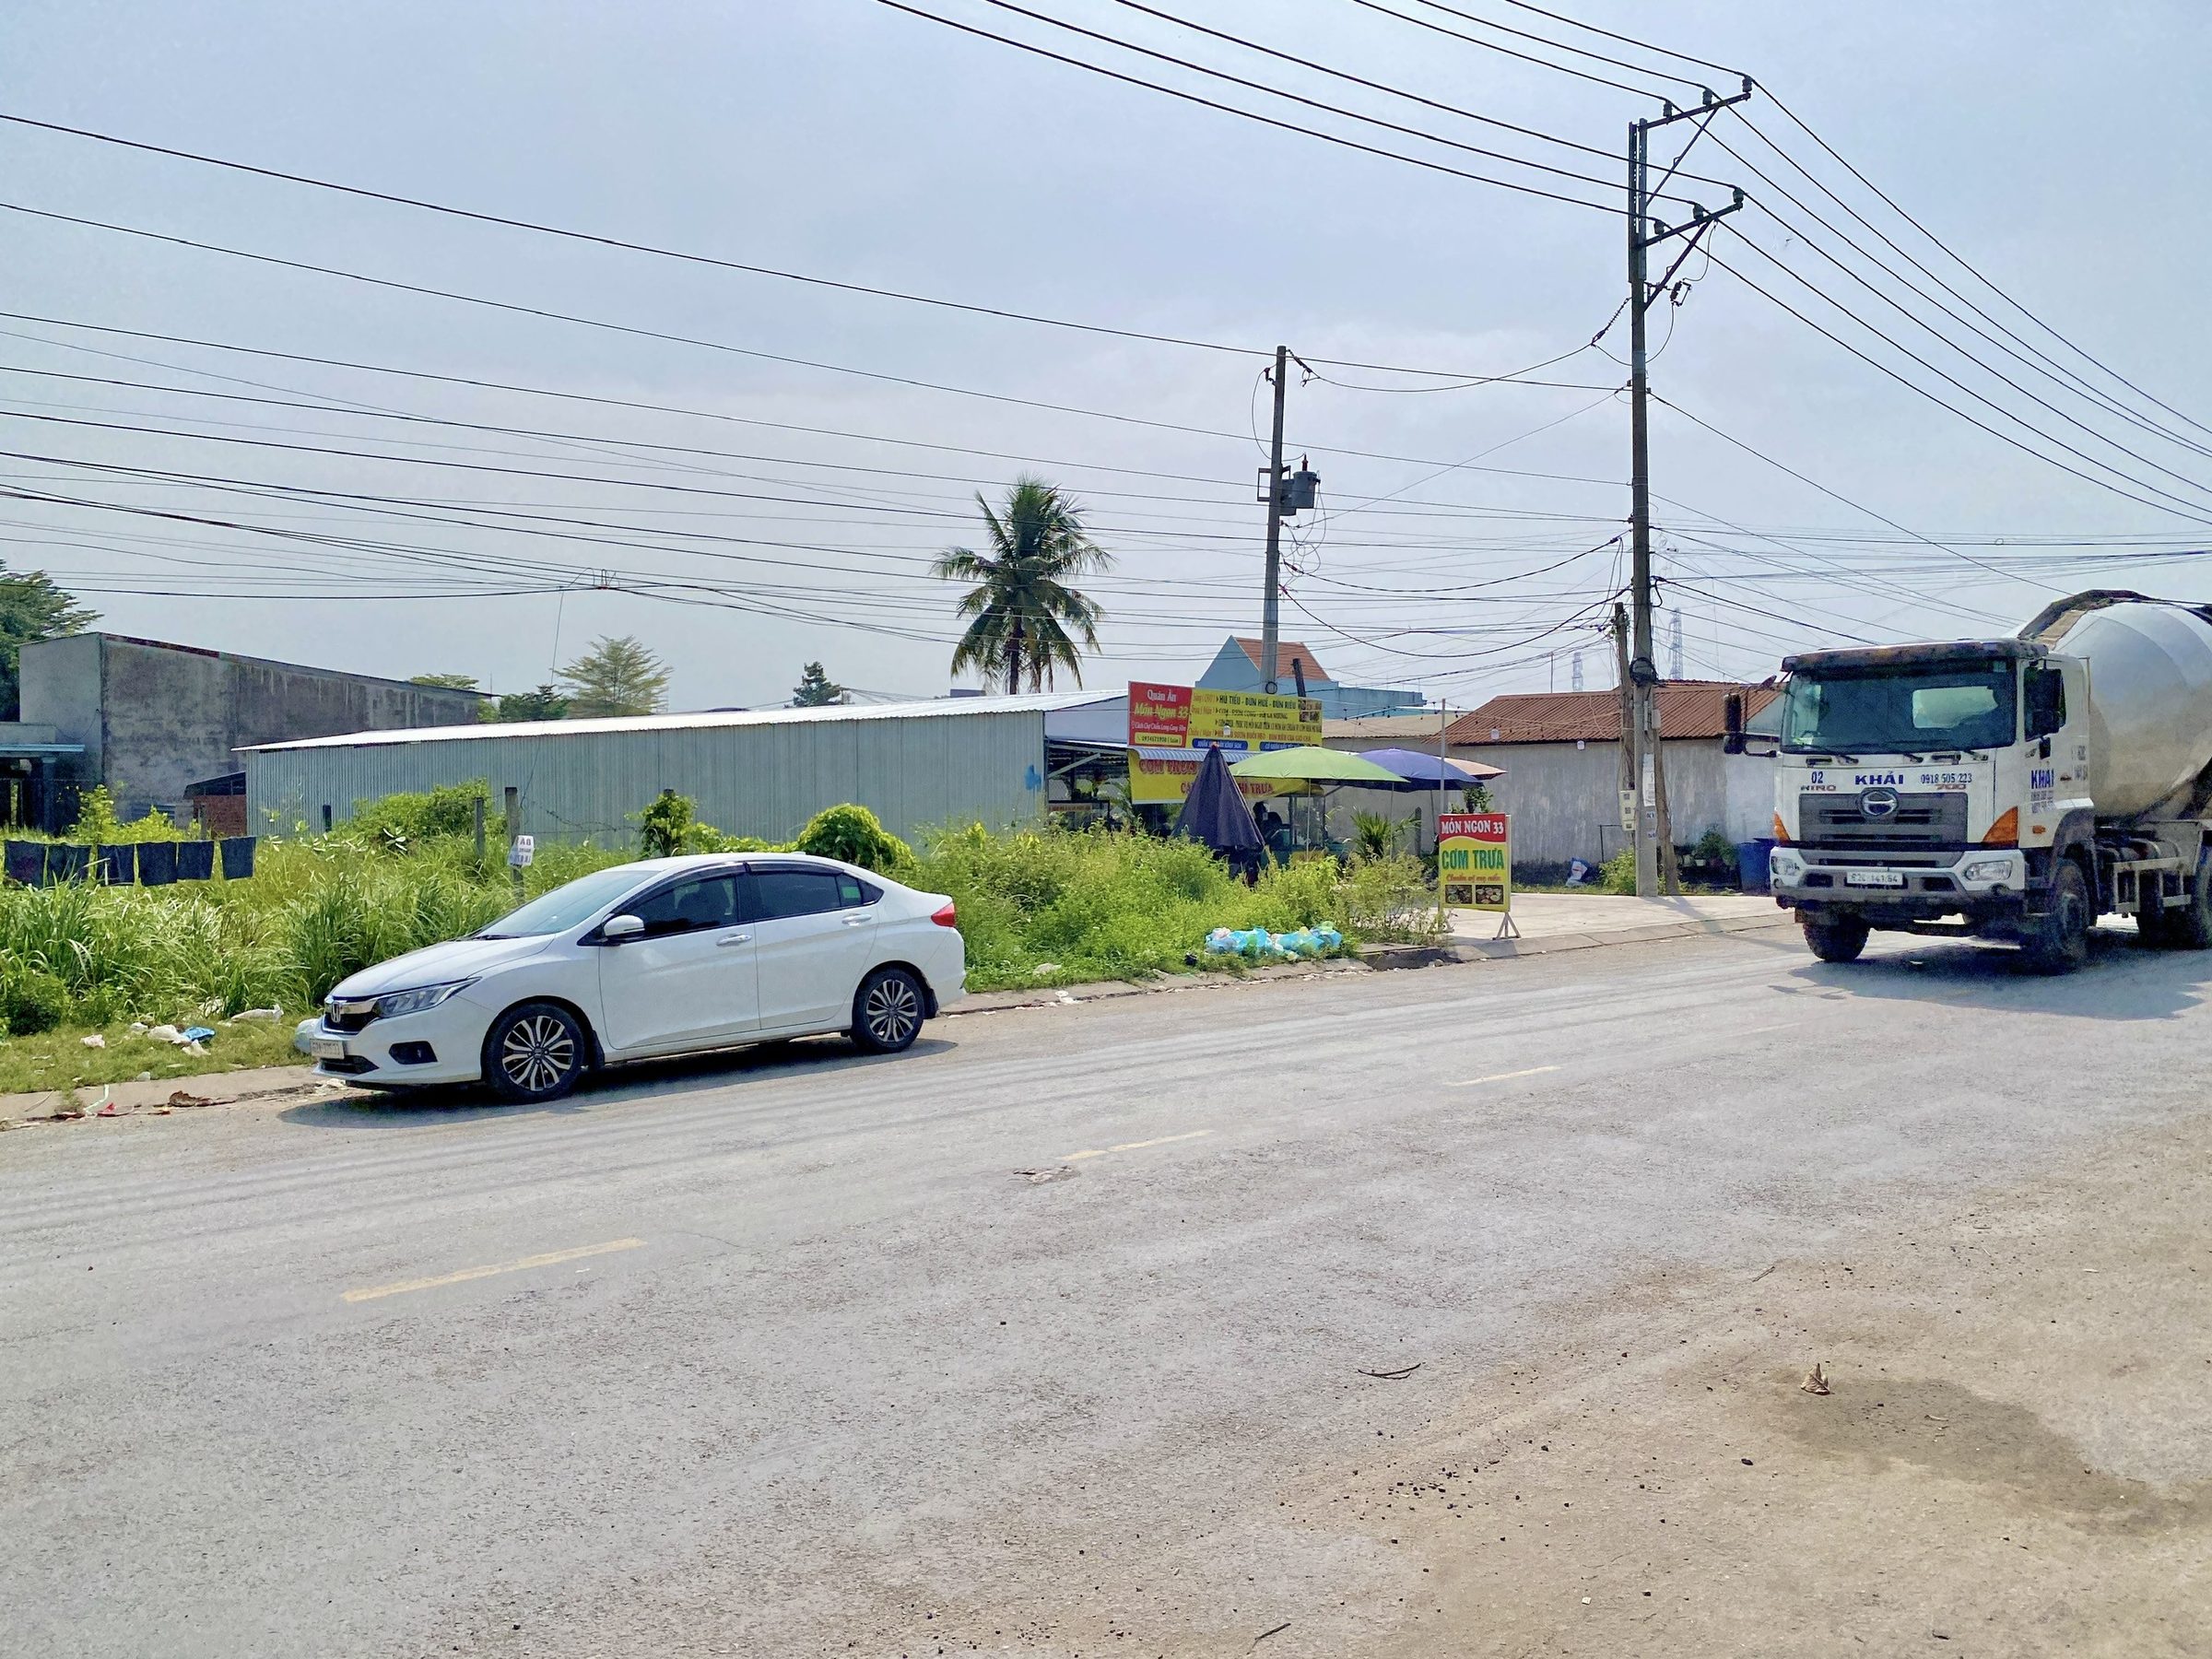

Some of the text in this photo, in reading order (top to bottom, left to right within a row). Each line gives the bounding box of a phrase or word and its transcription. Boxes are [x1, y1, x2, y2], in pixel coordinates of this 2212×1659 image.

[1147, 688, 1166, 701] Quán
[1155, 703, 1177, 720] Ngon
[1178, 706, 1189, 718] 33
[1811, 771, 1824, 784] 02
[1854, 771, 1904, 784] KHẢI
[1441, 818, 1504, 834] MÓN NGON 33
[1441, 847, 1505, 870] CƠM TRƯA
